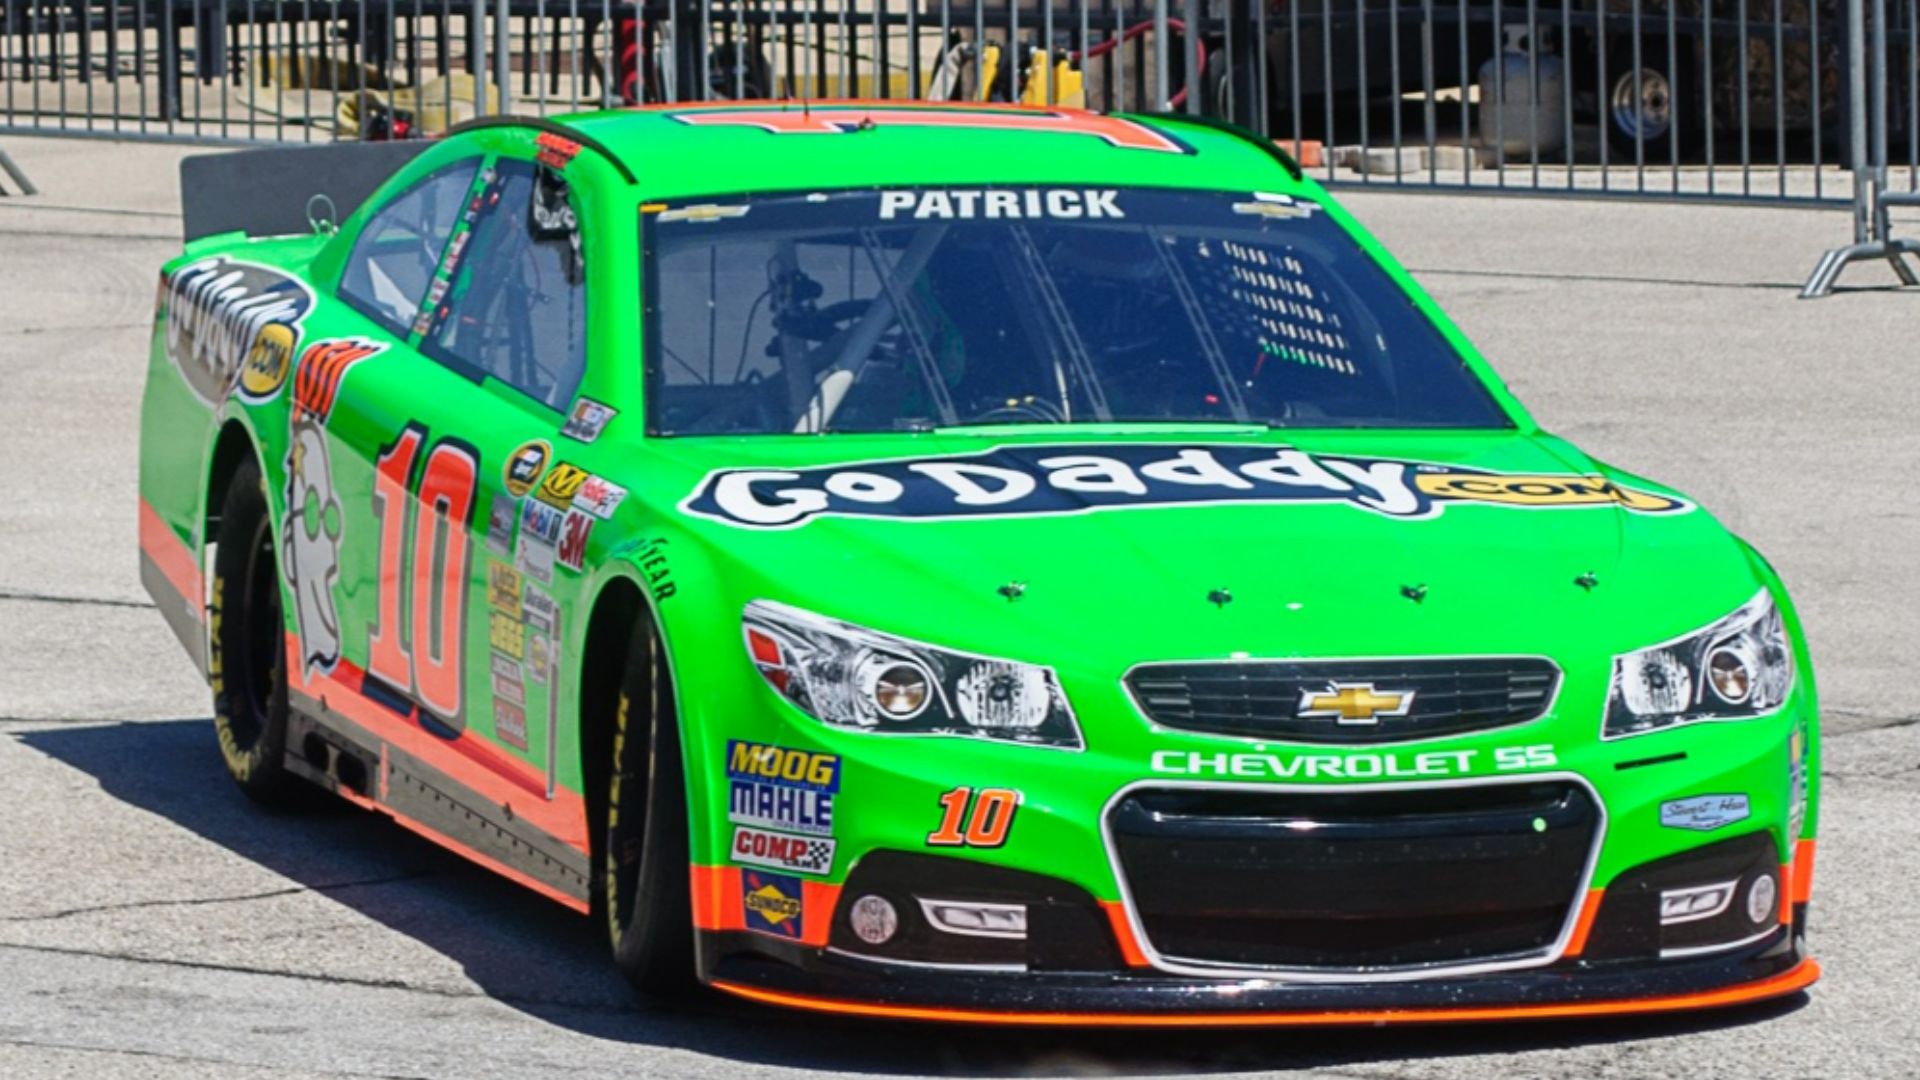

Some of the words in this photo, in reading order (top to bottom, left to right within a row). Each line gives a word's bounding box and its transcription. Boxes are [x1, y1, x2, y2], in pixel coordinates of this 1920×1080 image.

[878, 189, 1126, 219] PATRICK
[557, 510, 595, 571] 3M
[366, 422, 477, 722] 10
[730, 742, 837, 785] MOOG
[1150, 749, 1478, 777] CHEVROLET
[731, 780, 832, 827] MAHLE
[927, 786, 1022, 847] 10
[735, 830, 808, 862] COMP
